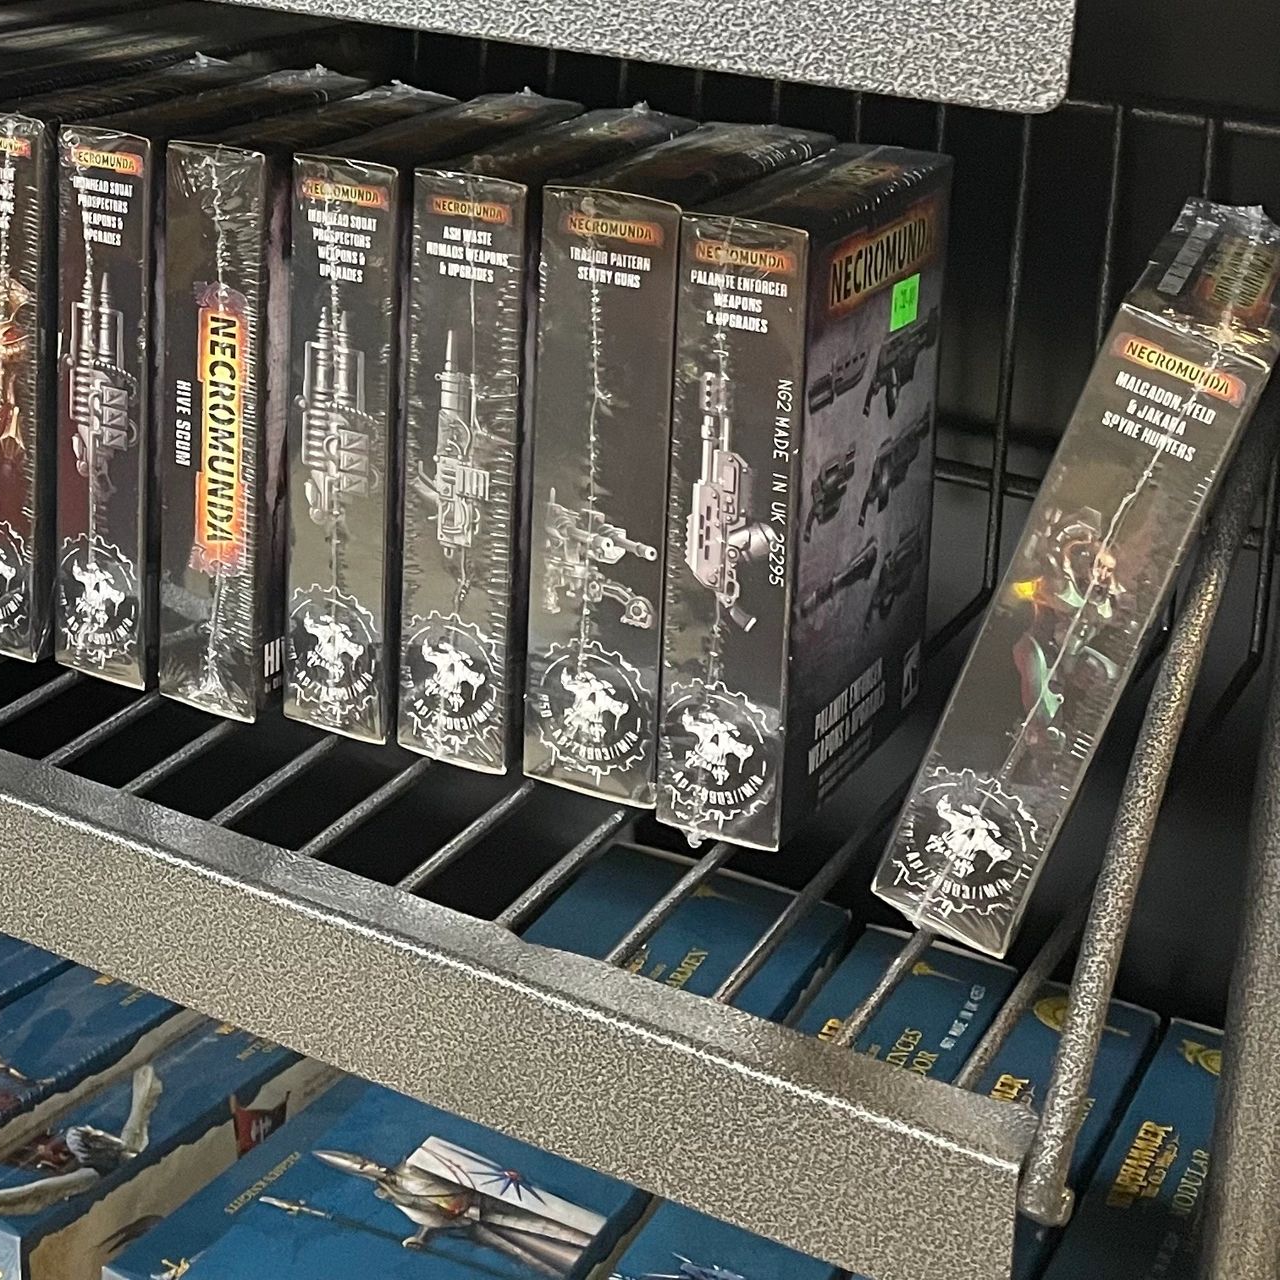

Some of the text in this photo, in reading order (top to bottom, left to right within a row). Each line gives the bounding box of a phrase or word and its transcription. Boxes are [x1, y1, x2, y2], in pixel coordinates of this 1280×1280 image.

[110, 181, 133, 198] SQUAT
[435, 200, 503, 219] NECROMUNDA
[350, 216, 377, 232] SQUAT
[569, 216, 652, 240] NECROMUNDA
[312, 227, 372, 249] PROSPECTORS
[443, 226, 492, 246] ASH WASTE
[317, 246, 357, 264] WEAPONS
[426, 241, 509, 268] NOMADS WEAPONS
[610, 251, 651, 272] PATTERN
[319, 263, 363, 283] UPGRADES
[447, 263, 494, 283] UPGRADES
[578, 266, 641, 289] SENTRY GUNS
[690, 269, 788, 298] PALANITE ENFORCER
[713, 292, 762, 313] WEAPONS
[716, 311, 768, 334] UPGRADES
[1126, 342, 1229, 395] NECROMUNDA
[175, 380, 192, 467] HIVE SCUM
[206, 314, 238, 545] NECROMUNDA
[1136, 404, 1187, 436] JAKARA
[1101, 410, 1196, 462] SPYRE HUNTERS
[768, 378, 793, 588] NG2 MADE IN UK 25295
[814, 688, 849, 741] PALANITE
[808, 721, 844, 776] WEAPONS
